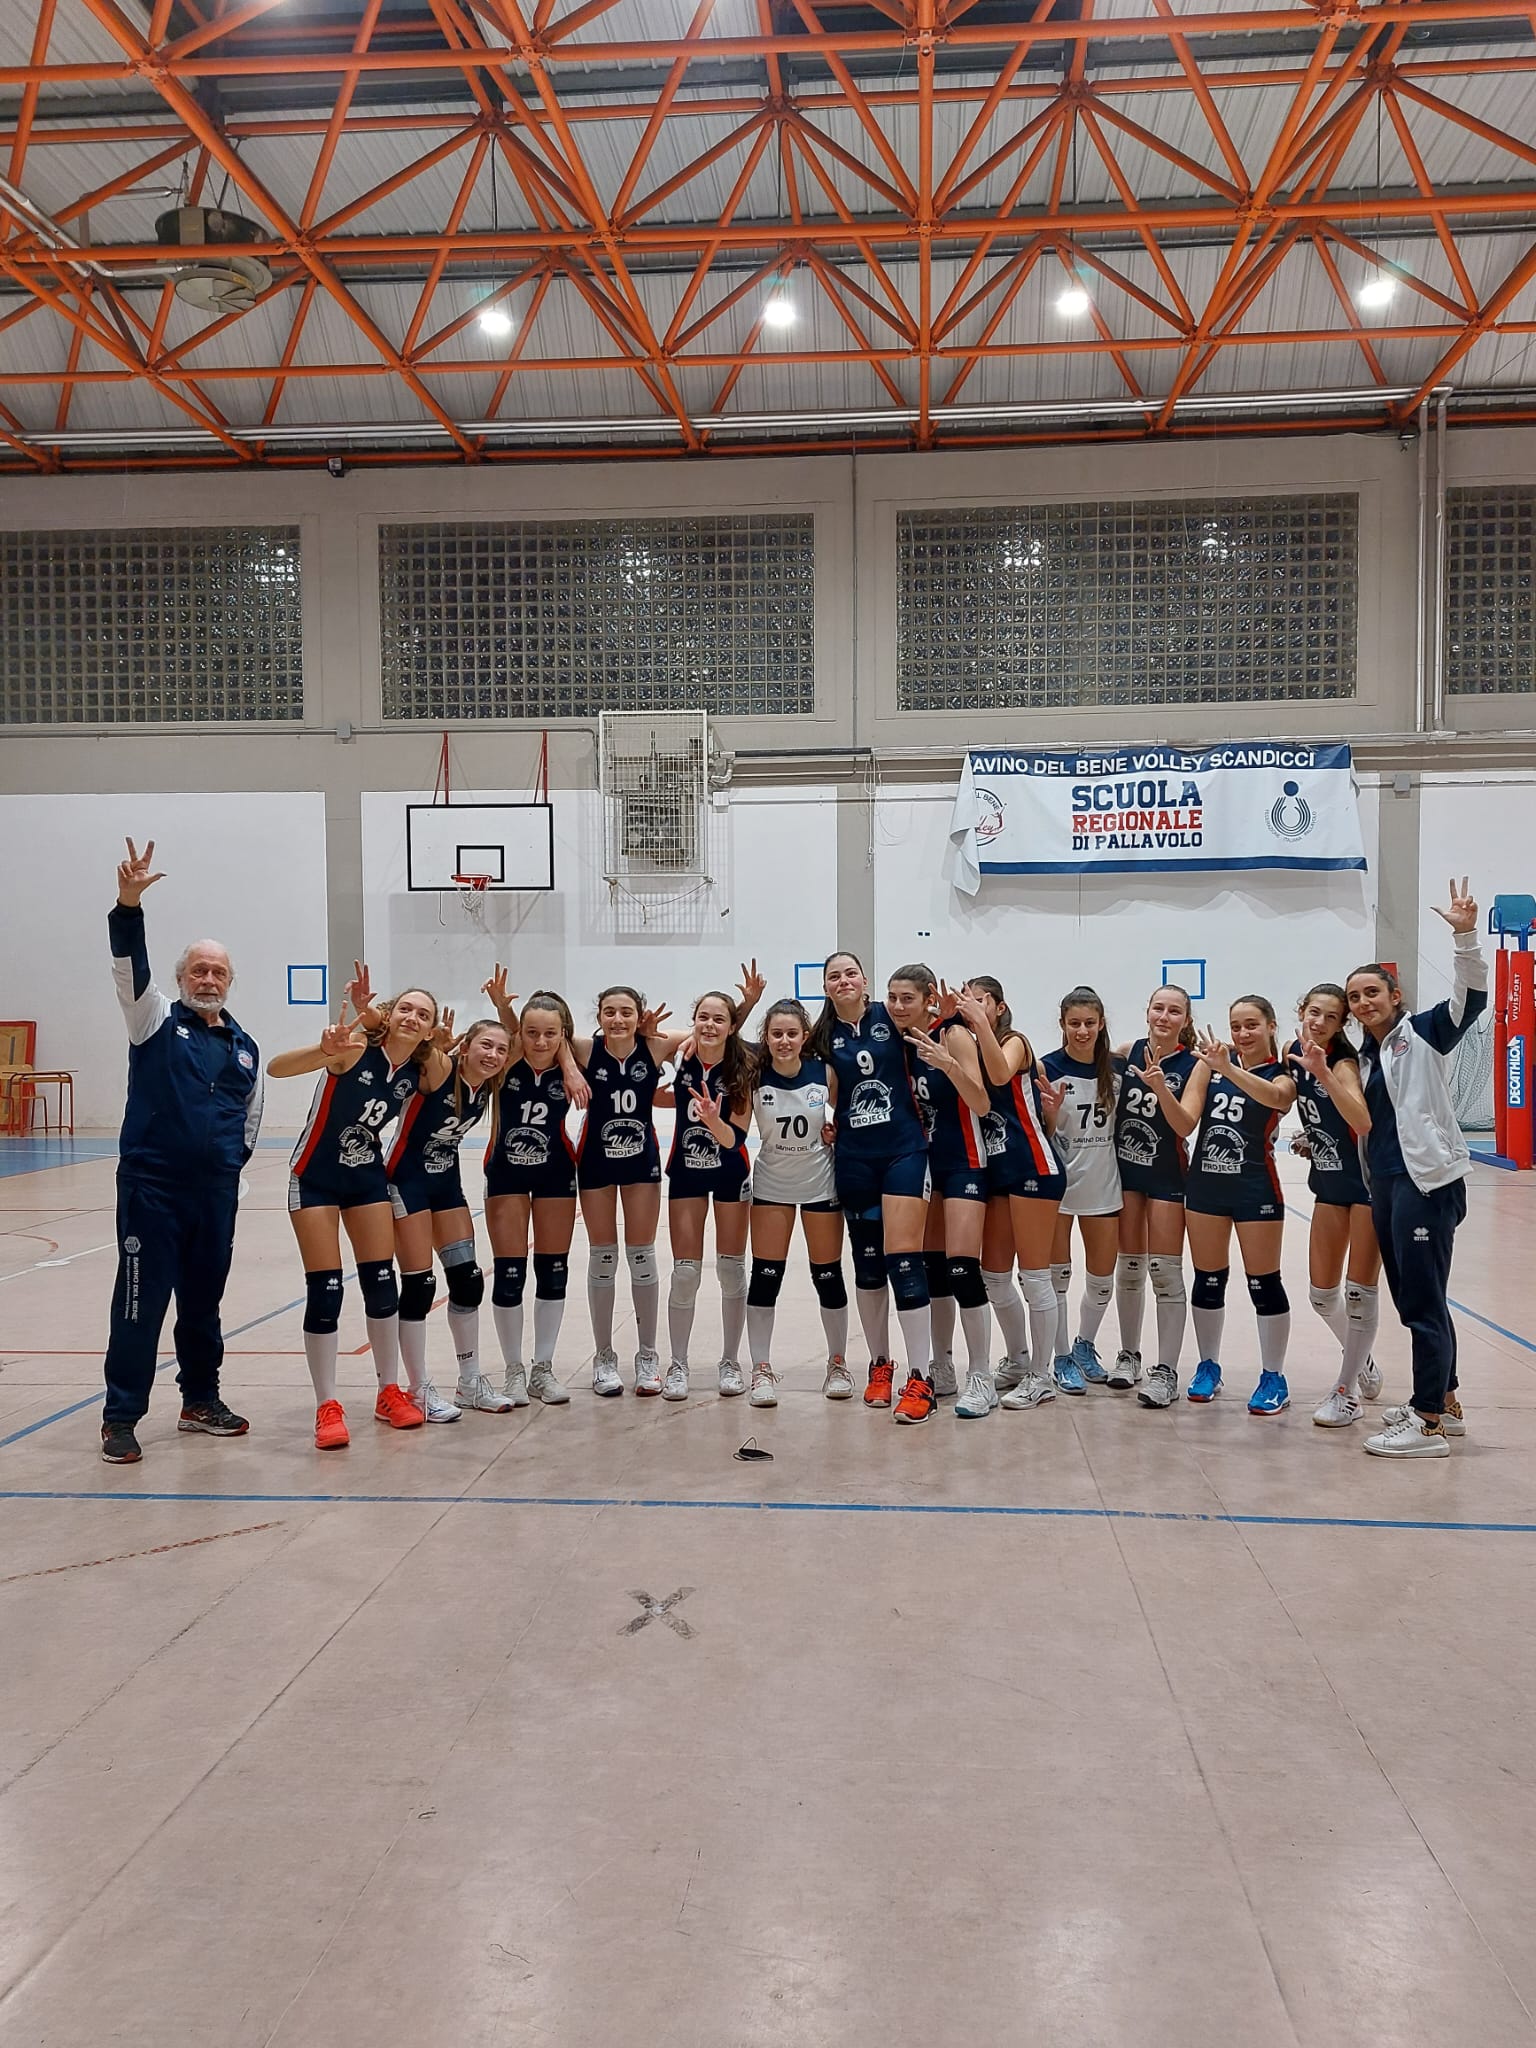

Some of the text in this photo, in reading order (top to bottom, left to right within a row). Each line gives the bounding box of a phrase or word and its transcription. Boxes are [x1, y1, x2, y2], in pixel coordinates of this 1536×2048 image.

[971, 749, 1316, 774] AVINO DEL BENE VOLLEY SCANDICCI
[1071, 780, 1202, 811] SCUOLA
[1072, 809, 1203, 833] REGIONALE
[1072, 832, 1203, 850] DI PALLAVOLO
[1512, 973, 1521, 1021] VIVISPORT
[856, 1050, 874, 1075] 9
[1508, 1037, 1521, 1105] DECATHLON
[358, 1098, 388, 1127] 13
[520, 1100, 549, 1125] 12
[610, 1089, 637, 1114] 10
[1126, 1087, 1158, 1118] 23
[1210, 1092, 1246, 1122] 25
[436, 1116, 477, 1136] 24
[775, 1114, 809, 1139] 70
[851, 1113, 887, 1127] PROJECT
[1076, 1102, 1108, 1130] 75
[508, 1154, 546, 1165] PROJECT
[607, 1147, 643, 1157] PROJECT
[686, 1159, 720, 1168] PROJECT
[1119, 1149, 1151, 1164] PROJECT
[1203, 1162, 1238, 1172] PROJECT
